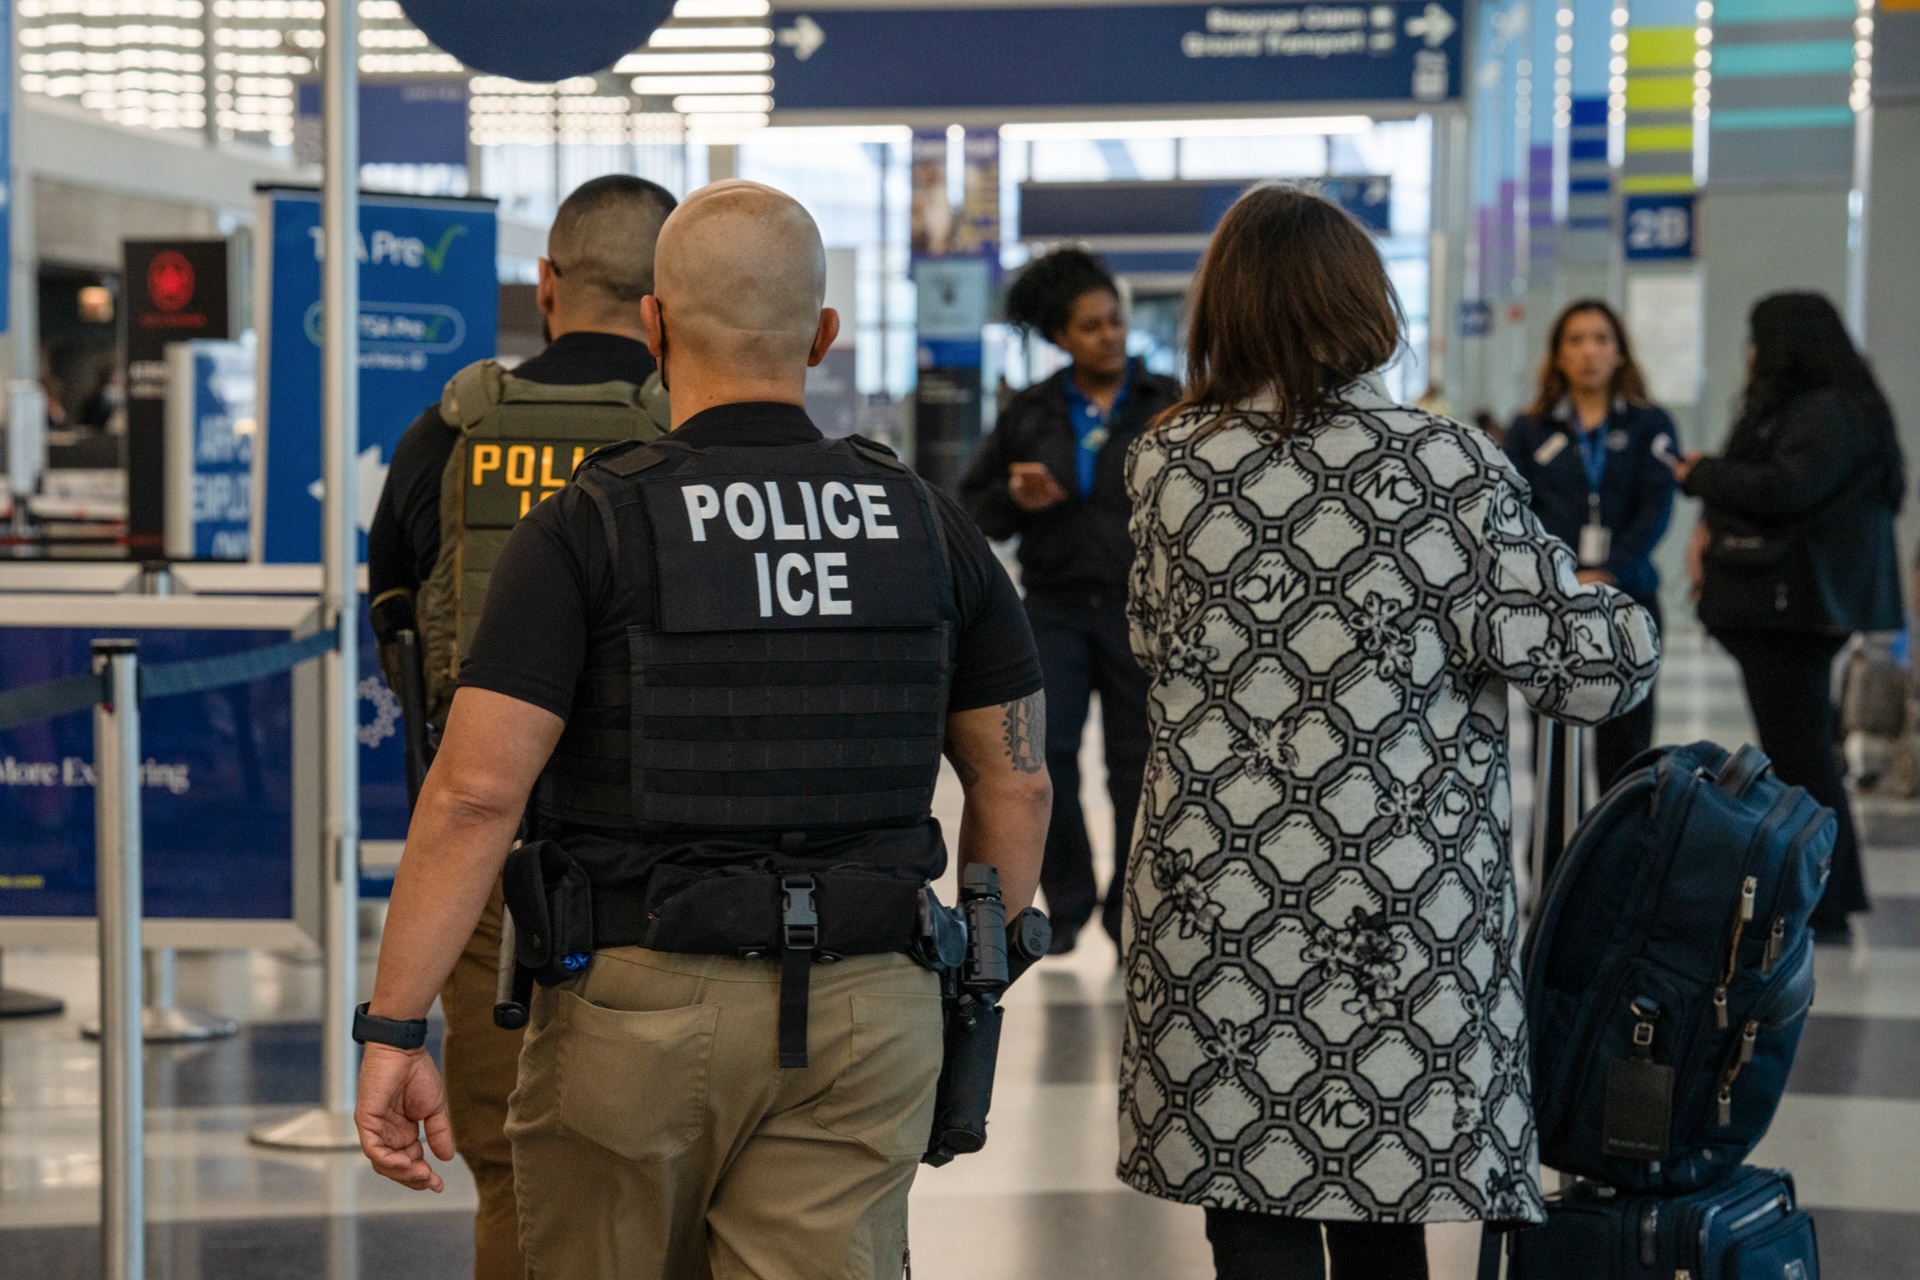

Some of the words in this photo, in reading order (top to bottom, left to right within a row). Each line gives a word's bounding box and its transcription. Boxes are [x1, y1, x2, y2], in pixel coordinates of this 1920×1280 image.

[307, 226, 368, 264] TA
[472, 444, 602, 488] POLI
[680, 481, 900, 543] POLICE
[754, 551, 853, 618] ICE
